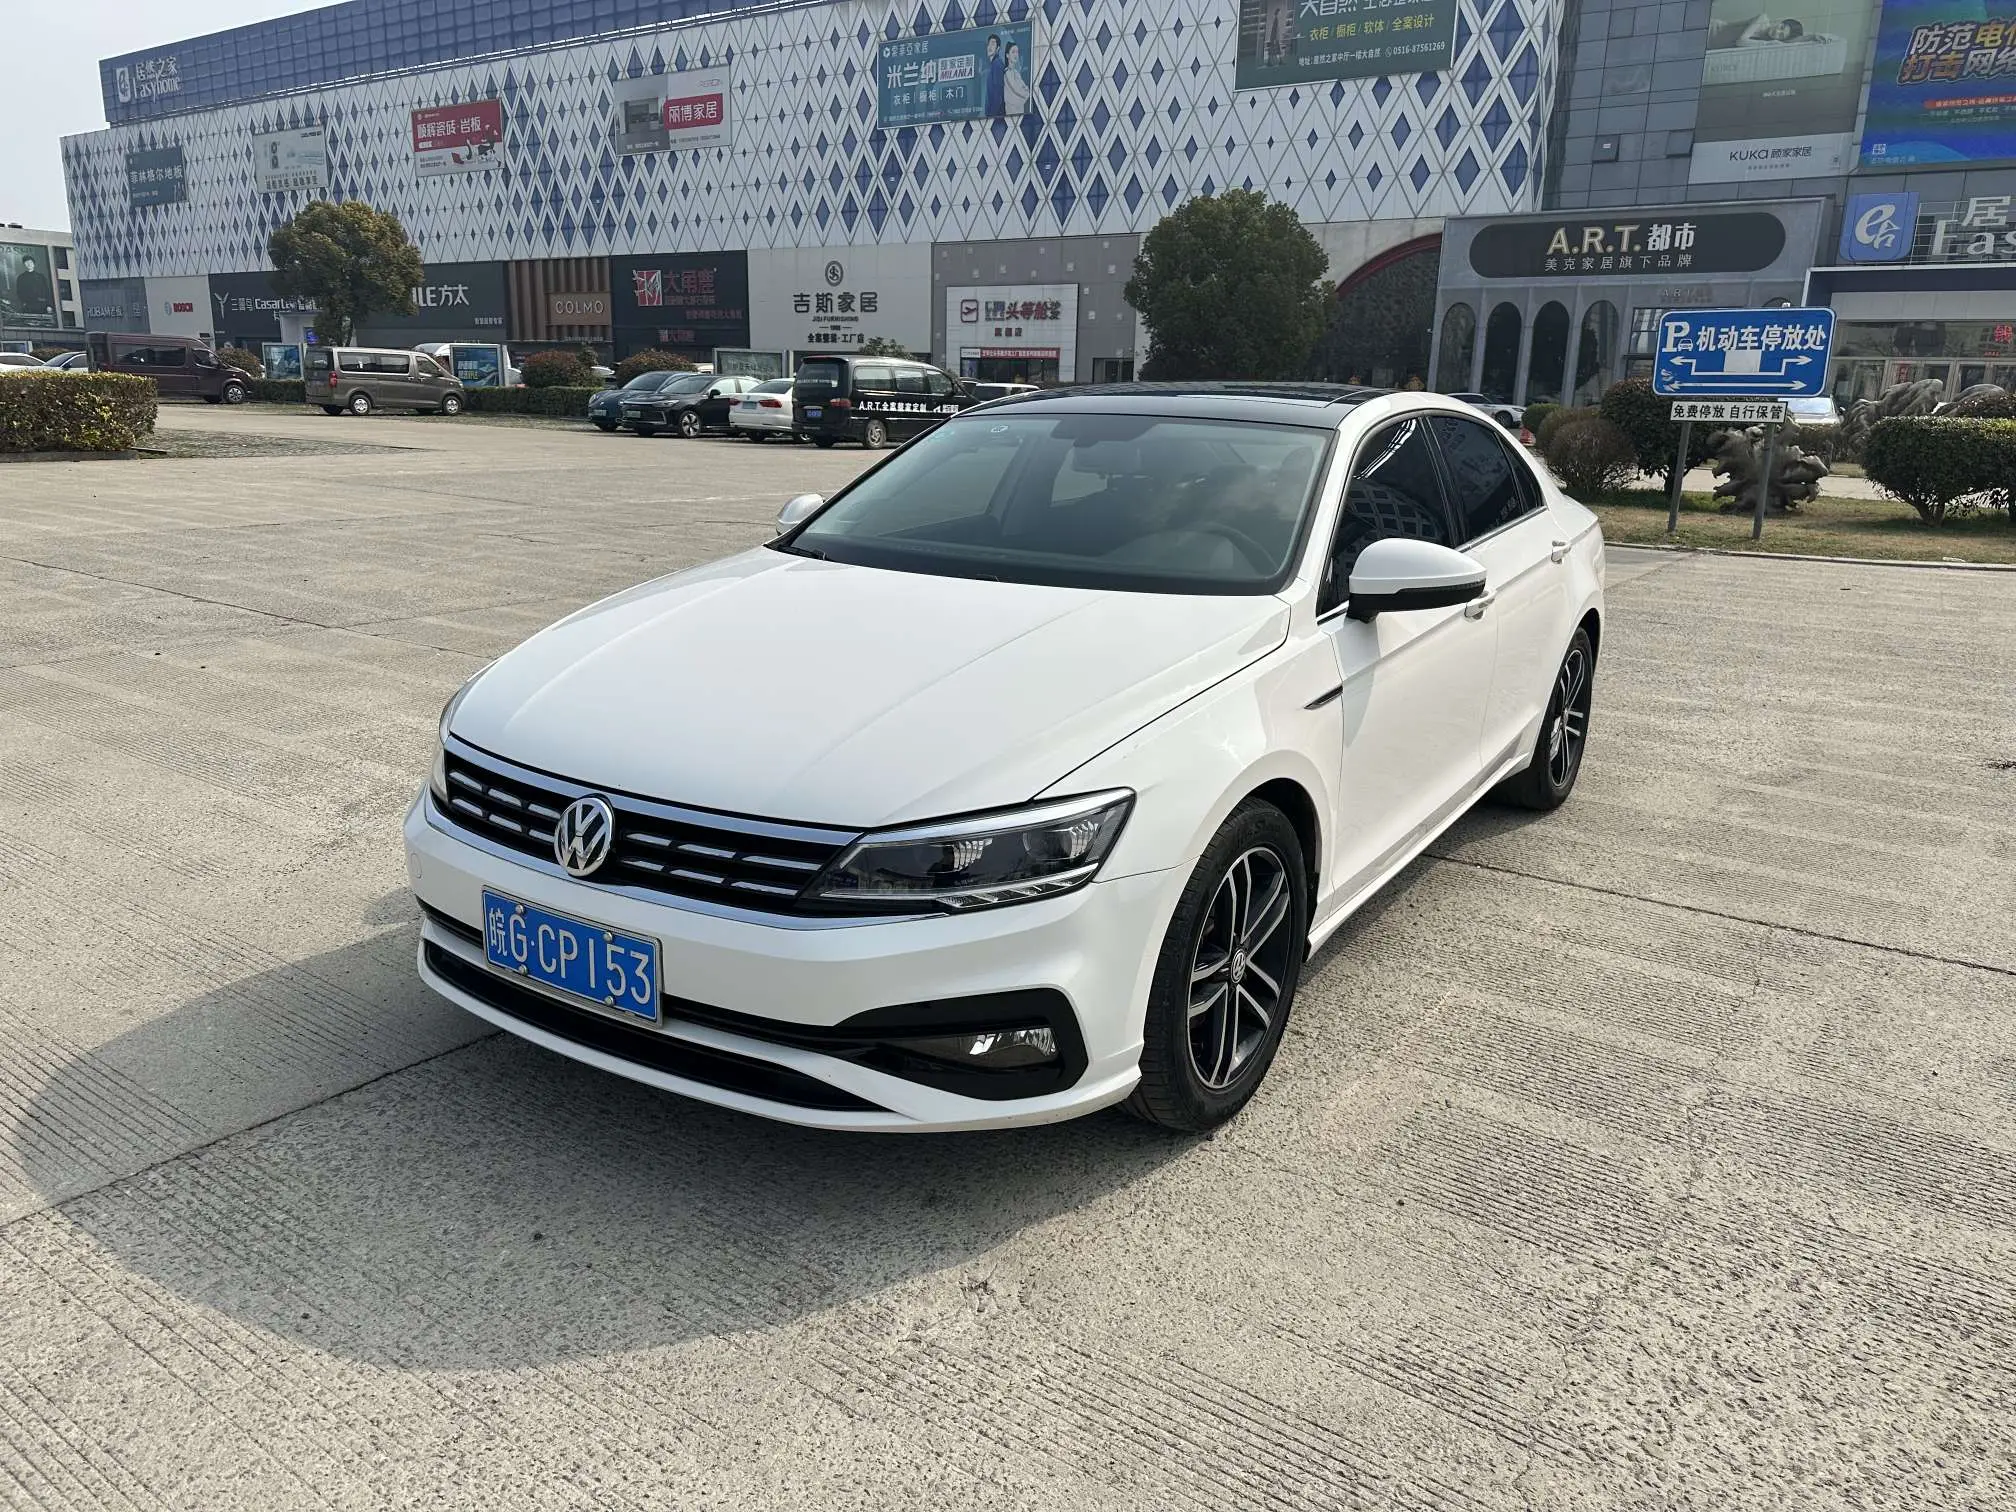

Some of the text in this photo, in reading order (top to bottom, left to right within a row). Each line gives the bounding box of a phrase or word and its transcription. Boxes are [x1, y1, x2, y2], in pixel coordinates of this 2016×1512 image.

[1309, 26, 1329, 41] 衣柜
[946, 87, 964, 99] 木门
[669, 101, 717, 122] 丽博家居
[1544, 254, 1693, 271] 美克家居旗下品牌
[438, 284, 470, 306] 方太
[793, 291, 878, 314] 吉斯家居
[555, 300, 604, 314] COLMO
[1662, 321, 1826, 352] P 机动车停放处
[1673, 404, 1783, 420] 免费停放 自行保管
